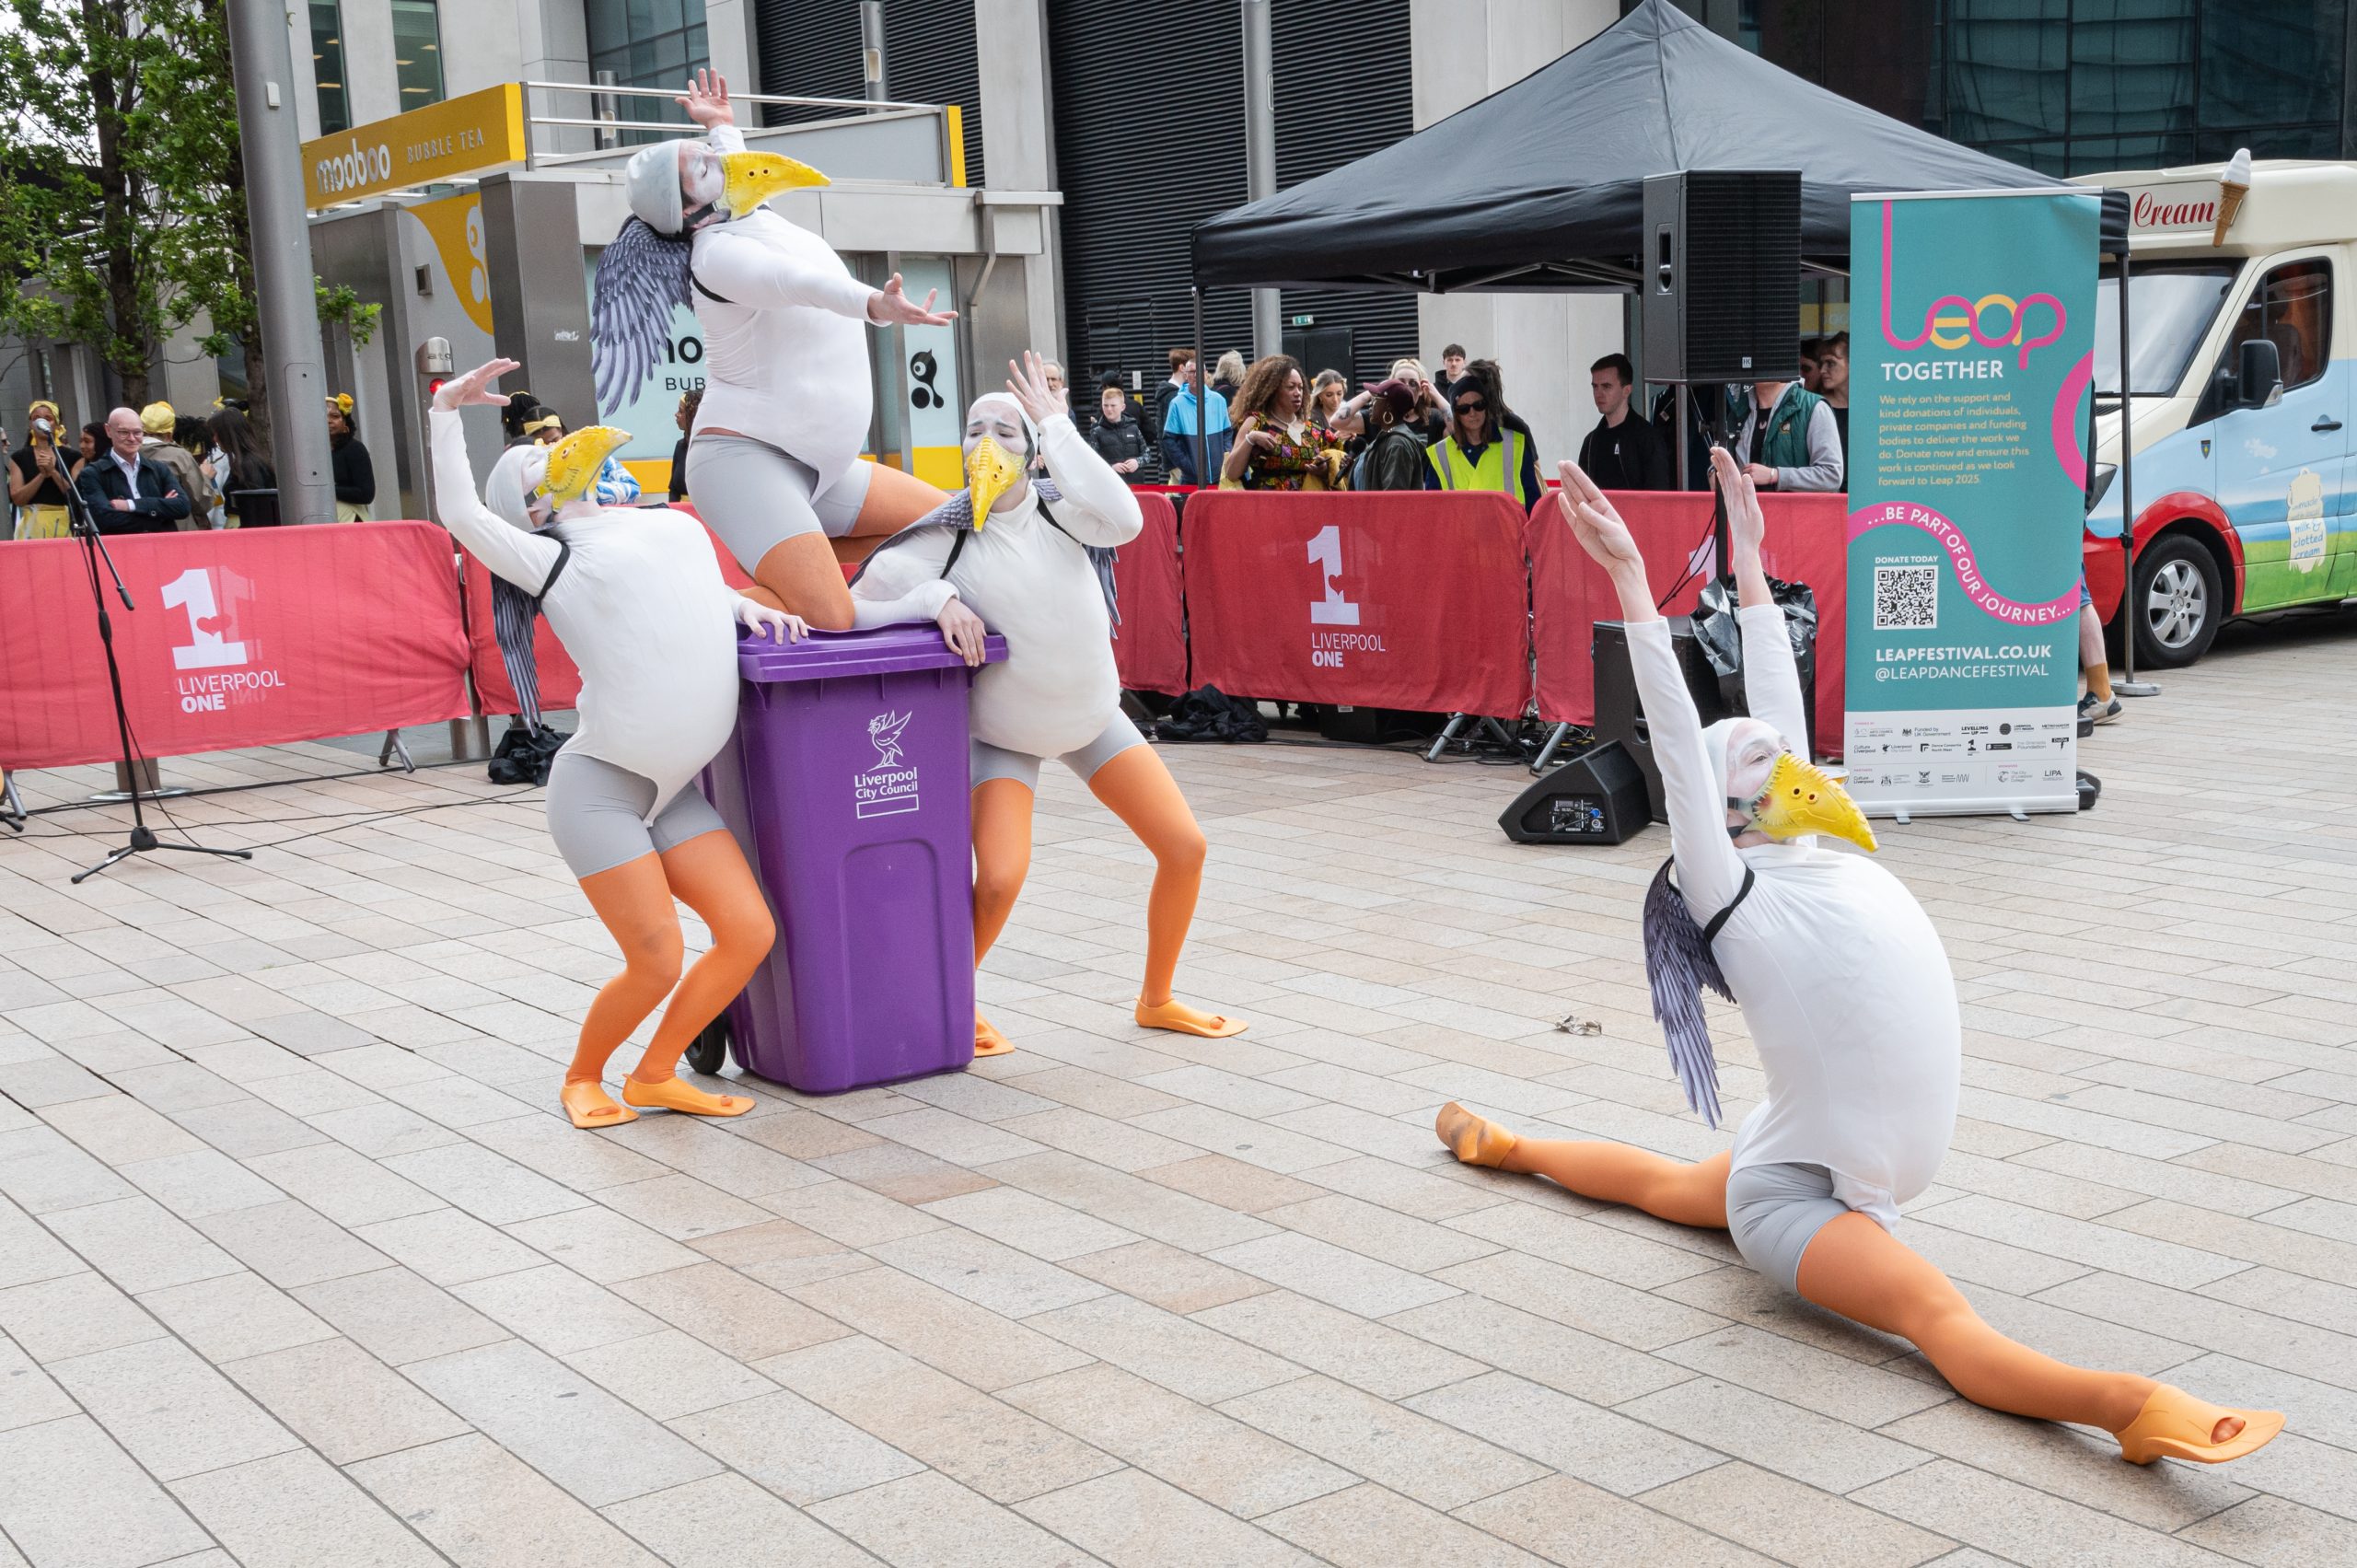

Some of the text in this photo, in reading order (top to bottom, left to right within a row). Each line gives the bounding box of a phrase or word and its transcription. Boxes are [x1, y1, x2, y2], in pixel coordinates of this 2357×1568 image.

[317, 127, 484, 193] mooboo BUBBLE TEA
[2134, 192, 2217, 227] Cream
[1881, 200, 2067, 370] Leap
[1881, 360, 2003, 381] TOGETHER
[1880, 391, 2011, 405] We rely on the support and
[1879, 405, 2021, 418] kind donations of individuals,
[1879, 419, 2027, 434] private companies and funding
[1879, 436, 1911, 446] bodies
[1914, 436, 1923, 444] to
[1926, 435, 1959, 444] deliver
[1962, 434, 1978, 443] the
[1980, 433, 2003, 443] work
[1897, 448, 1931, 459] Donate
[1933, 449, 1954, 458] now
[1956, 447, 1974, 457] and
[1976, 447, 2009, 457] ensure
[2011, 446, 2029, 456] this
[1879, 459, 2015, 472] work is continued as we look
[1879, 476, 1915, 486] forward
[1917, 475, 1927, 485] to
[1930, 475, 1953, 486] Leap
[2294, 521, 2311, 532] milk
[2293, 530, 2324, 548] clotted
[1875, 555, 1938, 564] DONATE TODAY
[2295, 547, 2321, 560] cream
[1910, 508, 1950, 536] PART
[1945, 534, 1967, 555] OF
[1957, 556, 1981, 595] OUR
[1978, 592, 2071, 622] JOURNEY...
[1312, 632, 1386, 652] LIVERPOOL
[1312, 650, 1343, 668] ONE
[1875, 645, 2052, 662] LEAPFESTIVAL.CO.UK
[1875, 663, 2049, 681] @LEAPDANCEFESTIVAL
[178, 669, 285, 695] LIVERPOOL
[181, 692, 226, 714] ONE
[854, 767, 918, 787] Liverpool
[855, 781, 918, 800] City Council
